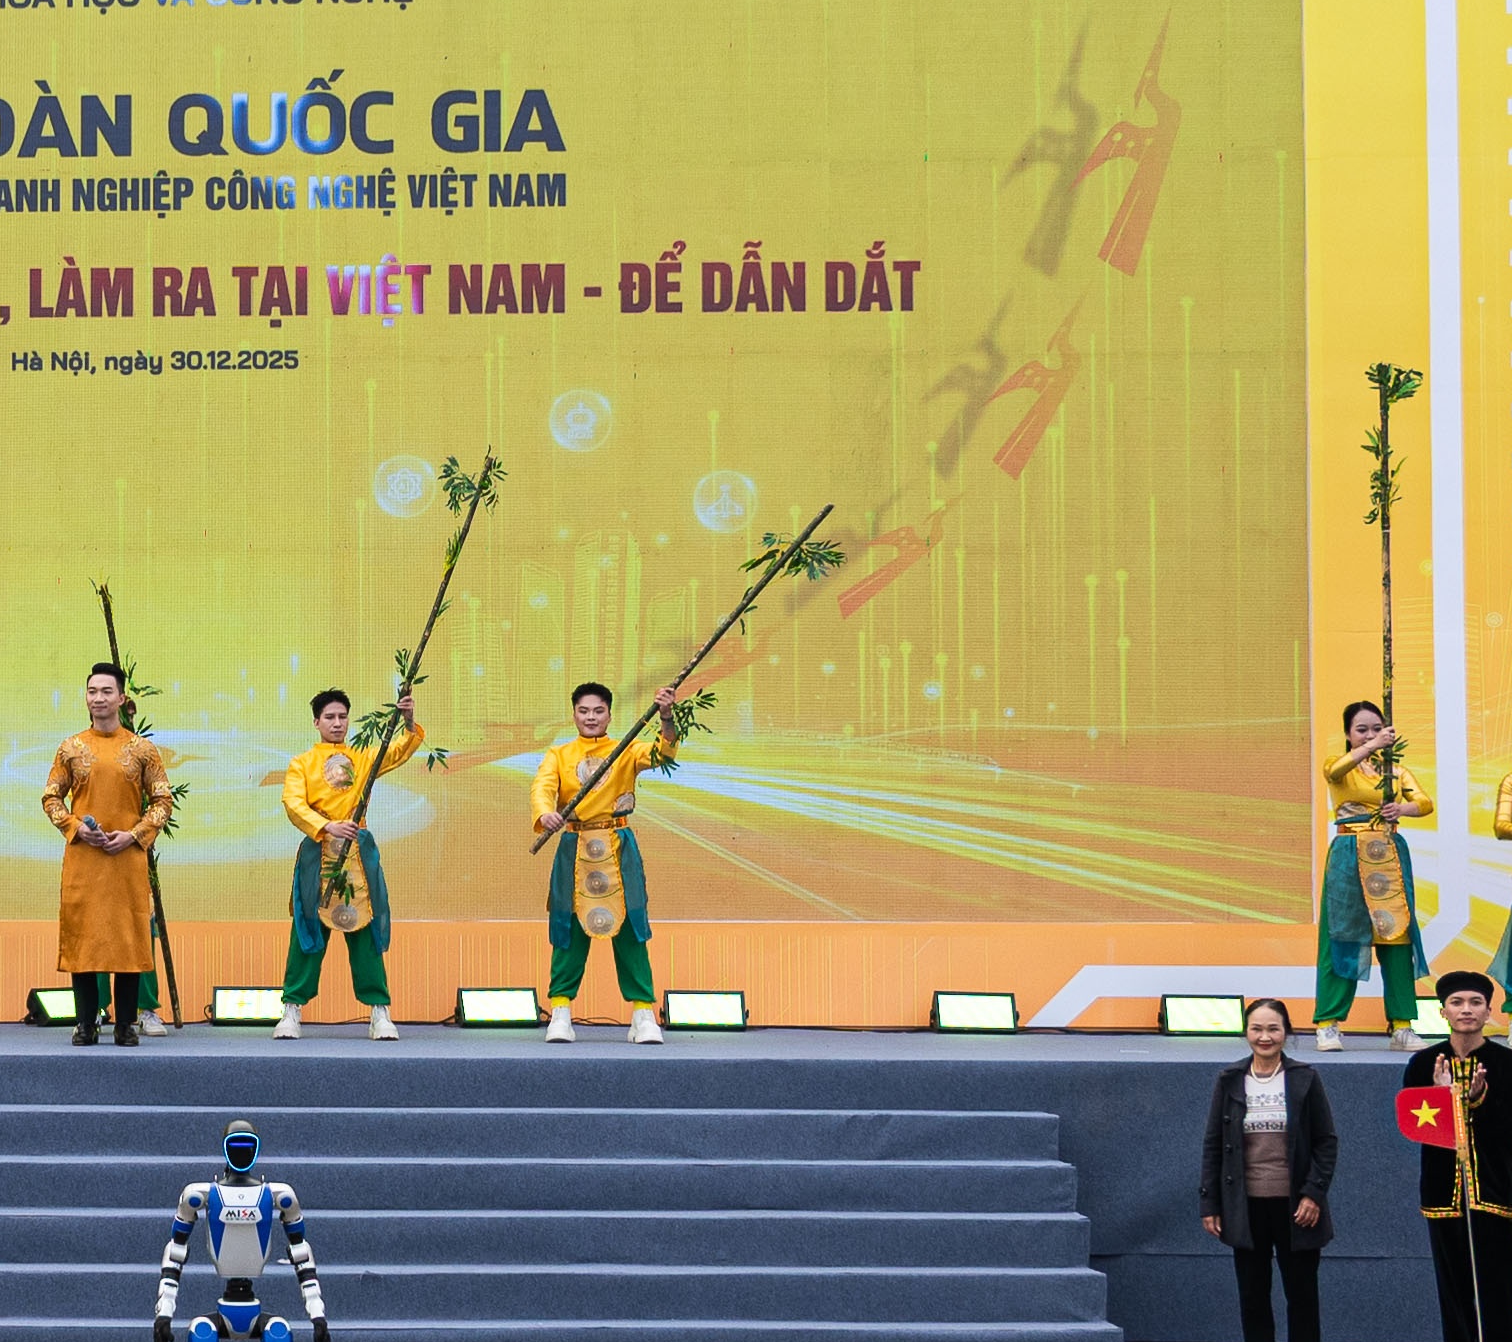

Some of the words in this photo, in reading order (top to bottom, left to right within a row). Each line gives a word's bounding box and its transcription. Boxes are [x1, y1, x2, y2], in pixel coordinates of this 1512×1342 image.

[167, 69, 394, 156] QUỐC
[431, 89, 567, 153] GIA
[74, 169, 194, 219] NGHIỆP
[205, 168, 296, 212] CÔNG
[307, 167, 396, 215] NGHỆ
[407, 166, 479, 215] VIỆT
[489, 173, 567, 208] NAM
[28, 256, 136, 321] LÀM
[152, 265, 216, 318] RA
[232, 264, 309, 328] TẠI
[325, 253, 431, 328] VIỆT
[448, 262, 566, 316] NAM
[618, 240, 686, 314] ĐỂ
[700, 240, 807, 314] DẪN
[825, 240, 922, 314] DẮT
[11, 350, 43, 372] Hà
[50, 350, 97, 377] Nội,
[104, 350, 163, 376] ngày
[170, 348, 299, 370] 30.12.2025
[225, 1208, 256, 1218] MISA
